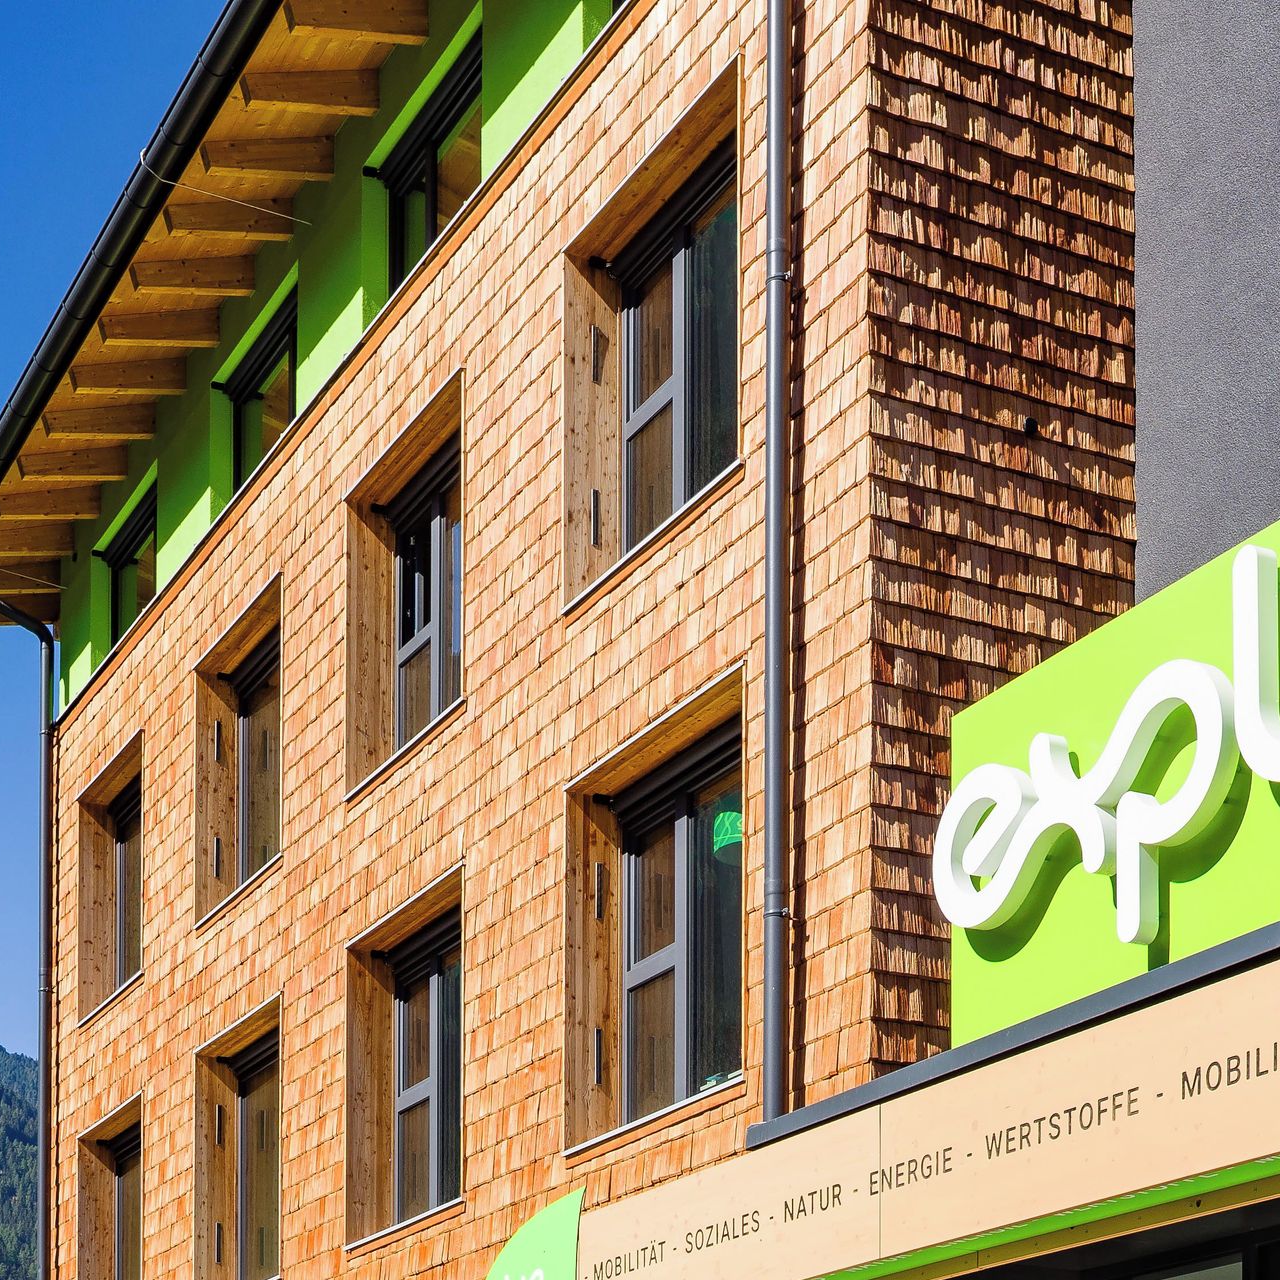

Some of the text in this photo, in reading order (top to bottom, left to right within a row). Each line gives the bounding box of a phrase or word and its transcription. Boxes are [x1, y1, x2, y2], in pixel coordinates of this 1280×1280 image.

[684, 1209, 761, 1254] SOZIALES
[783, 1182, 843, 1222] NATUR
[868, 1146, 953, 1197] ENERGIE
[985, 1086, 1140, 1160] WERTSTOFFE
